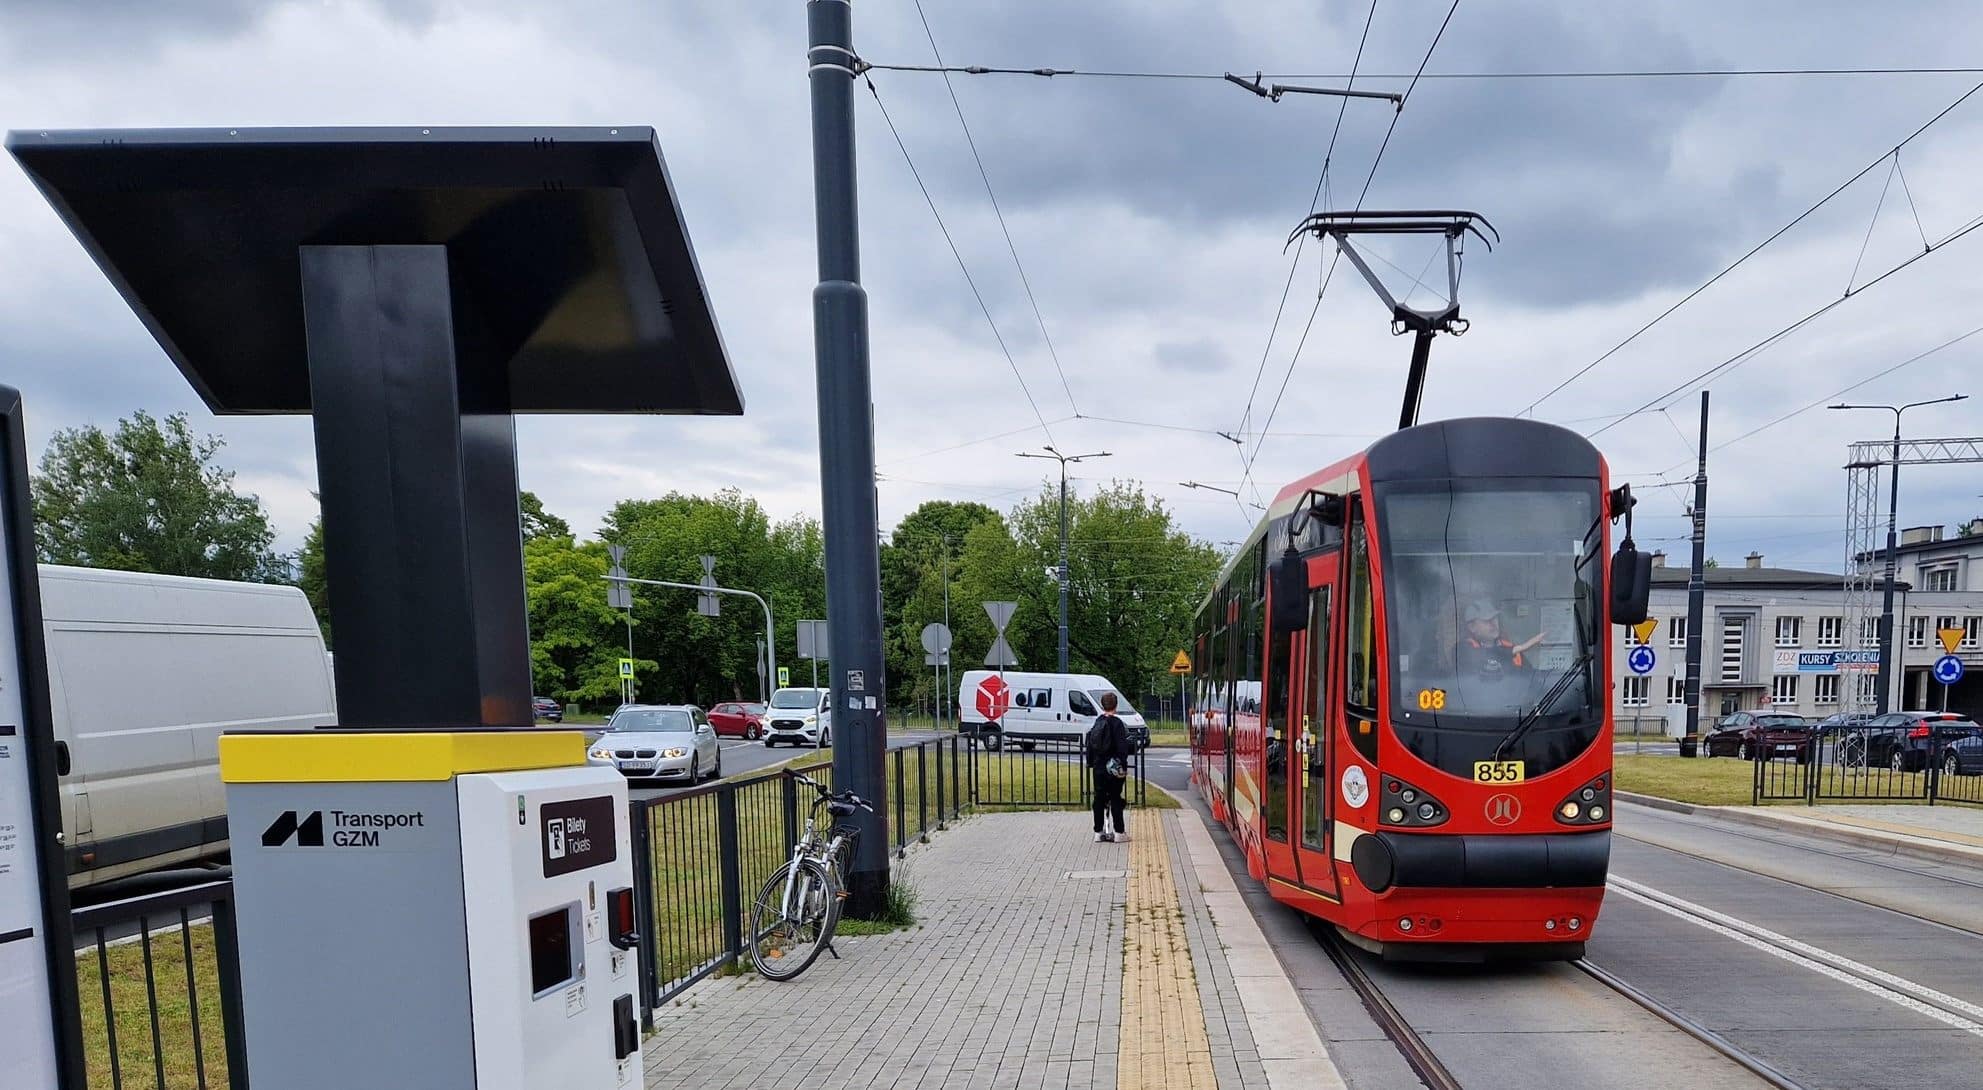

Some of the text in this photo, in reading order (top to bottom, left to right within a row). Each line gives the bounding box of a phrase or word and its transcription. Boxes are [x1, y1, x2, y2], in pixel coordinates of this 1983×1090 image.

[1801, 654, 1831, 665] KURSY
[1418, 689, 1446, 710] 08
[1478, 763, 1518, 782] 855
[331, 810, 424, 830] Transport
[566, 817, 586, 835] Bilety
[332, 831, 380, 847] GZM
[567, 838, 592, 855] Tickets
